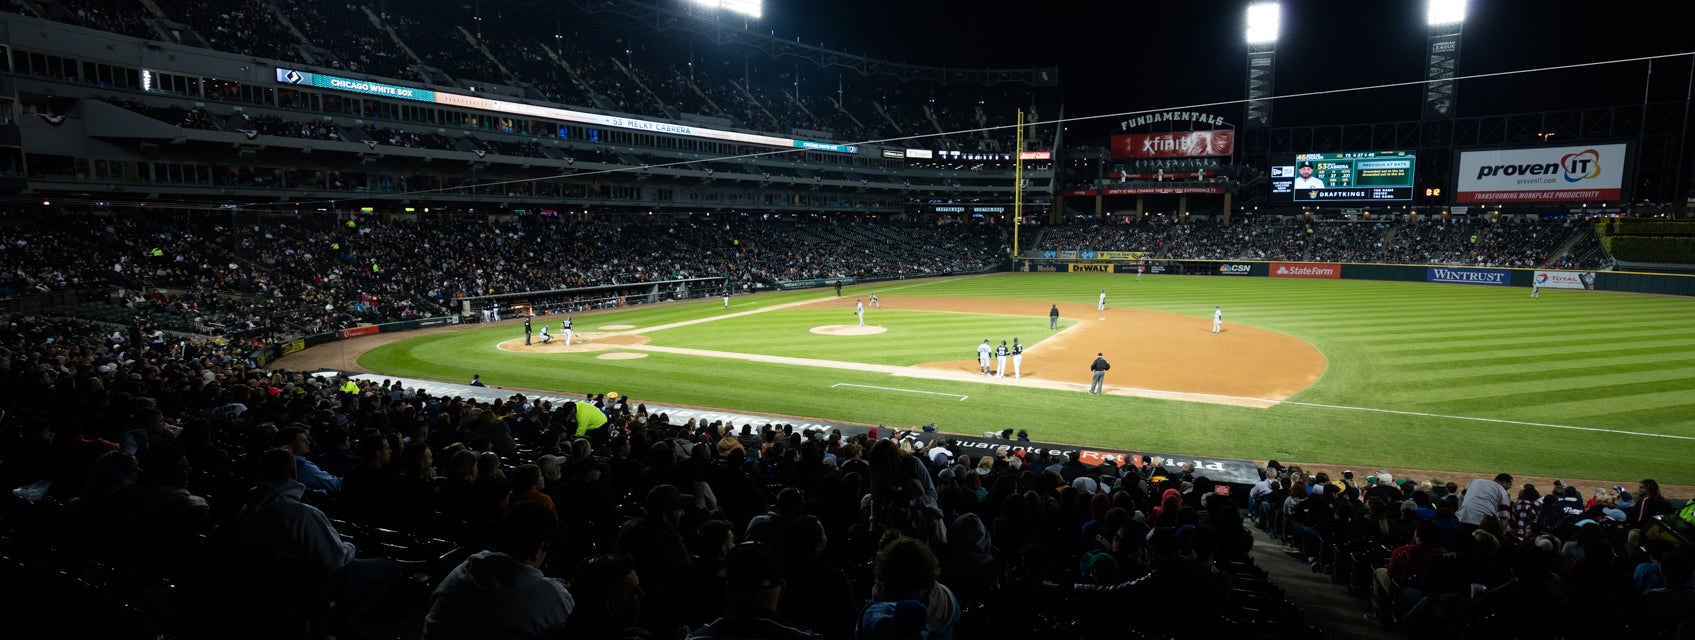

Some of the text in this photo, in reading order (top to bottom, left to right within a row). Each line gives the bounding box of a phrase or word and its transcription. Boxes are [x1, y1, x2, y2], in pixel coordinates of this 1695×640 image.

[331, 79, 412, 97] CHICAGO WHITE SOX
[627, 120, 653, 130] MELKY
[655, 124, 691, 134] CABRERA
[1121, 112, 1224, 130] FUNDAMENTALS
[1142, 136, 1198, 154] xfinity
[1477, 159, 1592, 180] proven IT
[1434, 268, 1504, 282] WINTRUST
[1151, 456, 1226, 471] ild
